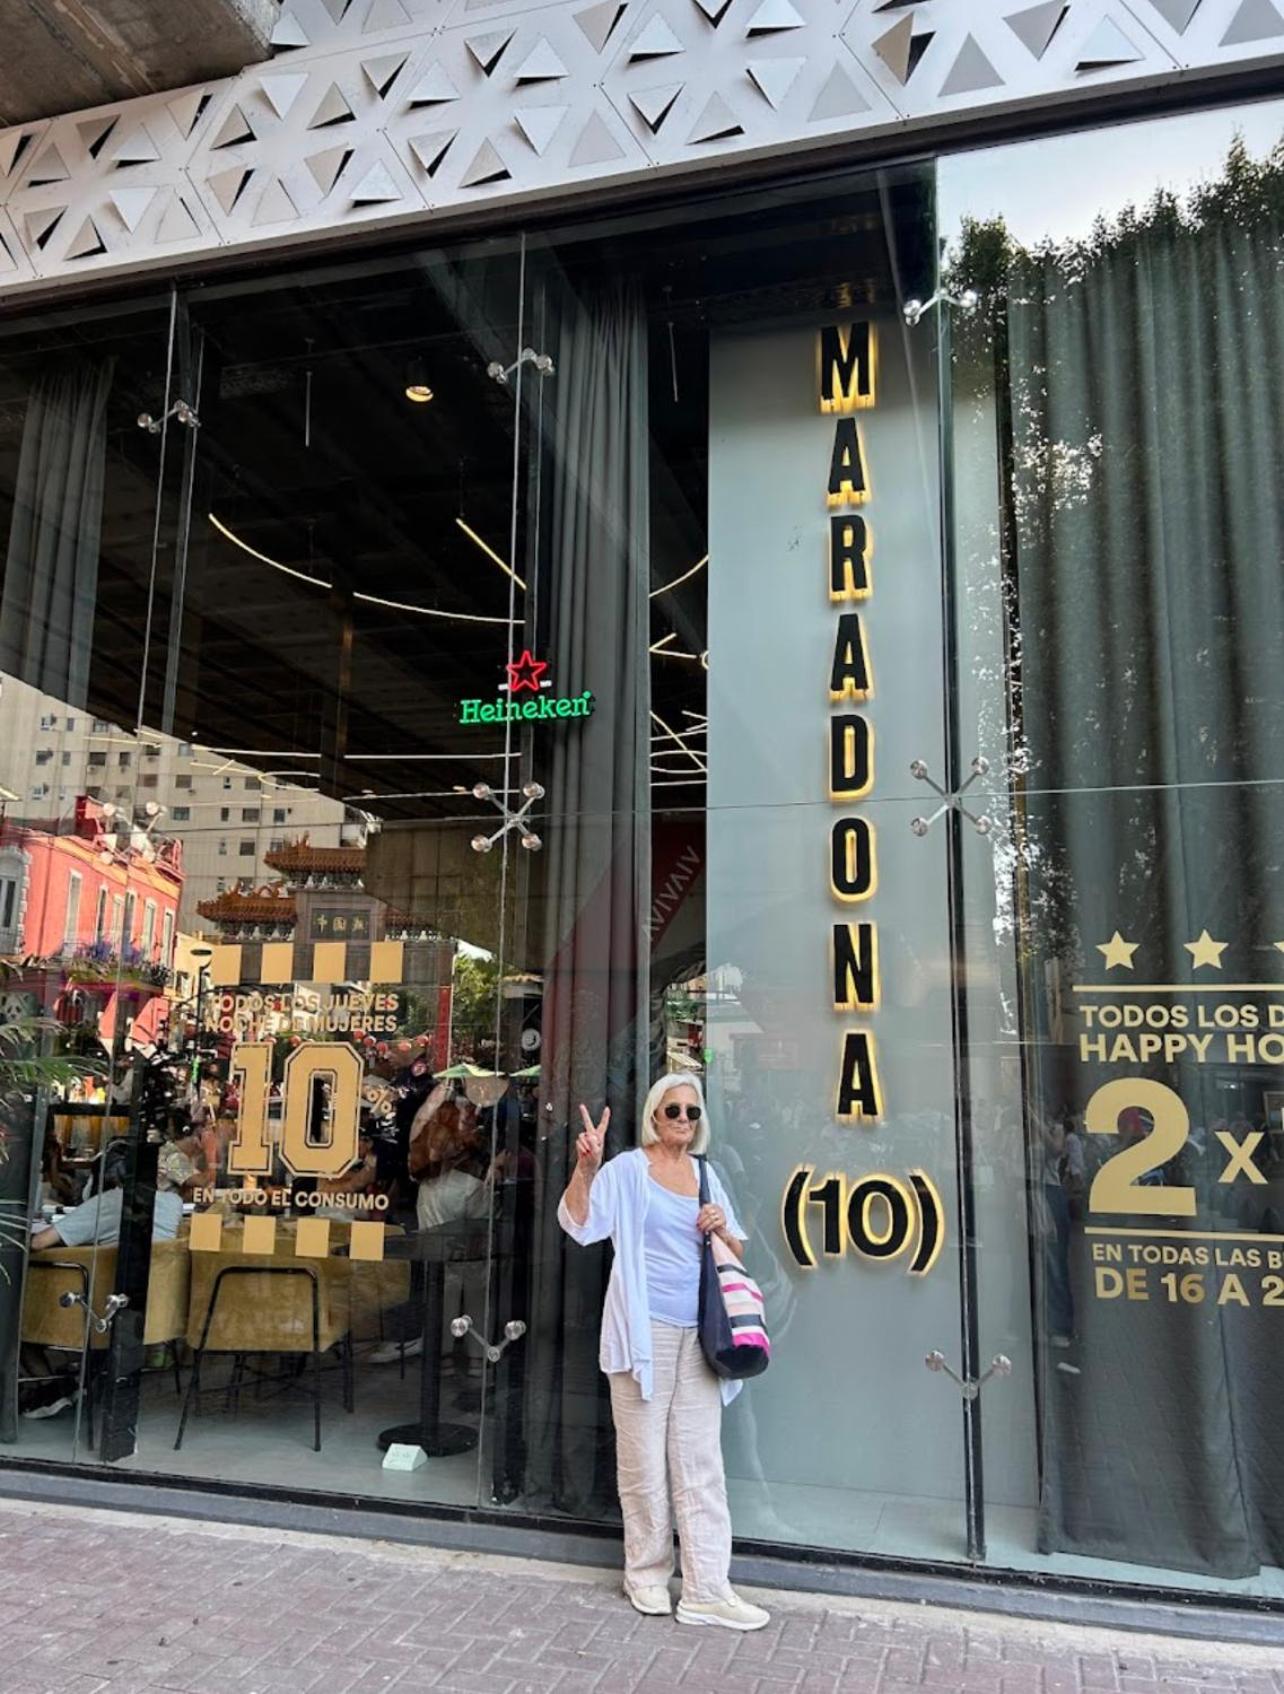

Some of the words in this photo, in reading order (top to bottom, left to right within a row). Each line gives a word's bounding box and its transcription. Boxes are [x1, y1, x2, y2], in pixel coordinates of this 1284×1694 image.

[459, 694, 592, 724] Heineken
[819, 320, 882, 1121] MARADONA
[280, 994, 320, 1012] LOS
[327, 993, 399, 1011] JUEVES
[1079, 1004, 1189, 1028] TODOS
[1197, 1004, 1260, 1028] LOS
[307, 1015, 398, 1033] MUJERES
[1079, 1033, 1214, 1063] HAPPY
[1085, 1077, 1197, 1216] 2
[193, 1187, 215, 1203] EN
[220, 1189, 268, 1206] TODO
[272, 1190, 291, 1207] EL
[294, 1192, 390, 1211] CONSUMO
[783, 1167, 943, 1273] (10)
[1092, 1243, 1123, 1262] EN
[1128, 1244, 1210, 1266] TODAS
[1215, 1247, 1262, 1268] LAS
[1095, 1266, 1149, 1301] DE
[1160, 1272, 1206, 1304] 16
[1217, 1273, 1251, 1307] A
